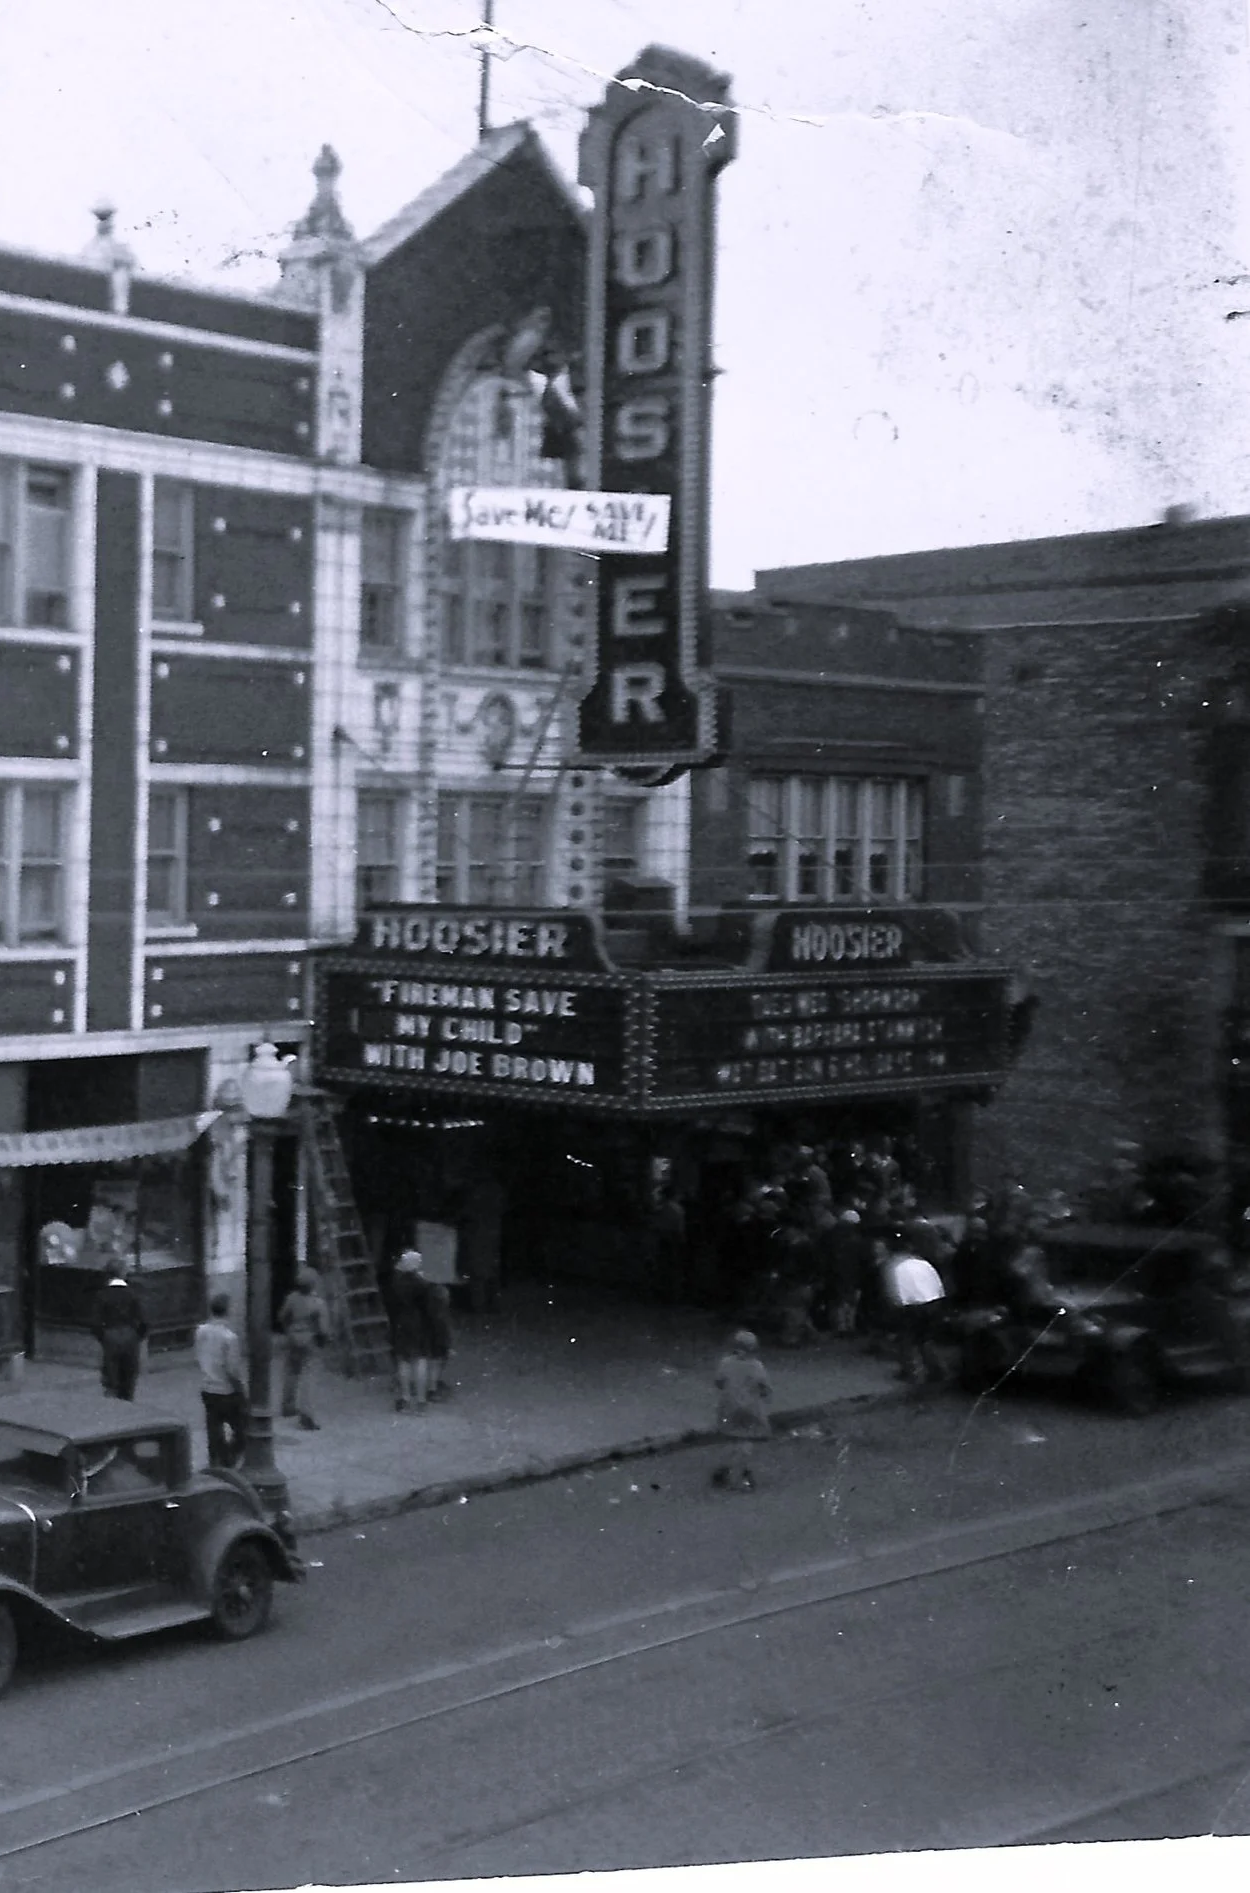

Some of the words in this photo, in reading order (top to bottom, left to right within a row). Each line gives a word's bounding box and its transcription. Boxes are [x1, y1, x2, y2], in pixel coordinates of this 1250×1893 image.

[611, 132, 681, 727] HOOSER
[371, 914, 569, 959] HOOSIER
[791, 920, 904, 962] HOOSIER
[504, 987, 578, 1017] SAVE
[393, 1012, 432, 1039] MY
[362, 1042, 426, 1071] WITH
[432, 1047, 485, 1076] JOE
[490, 1052, 597, 1087] BROWN
